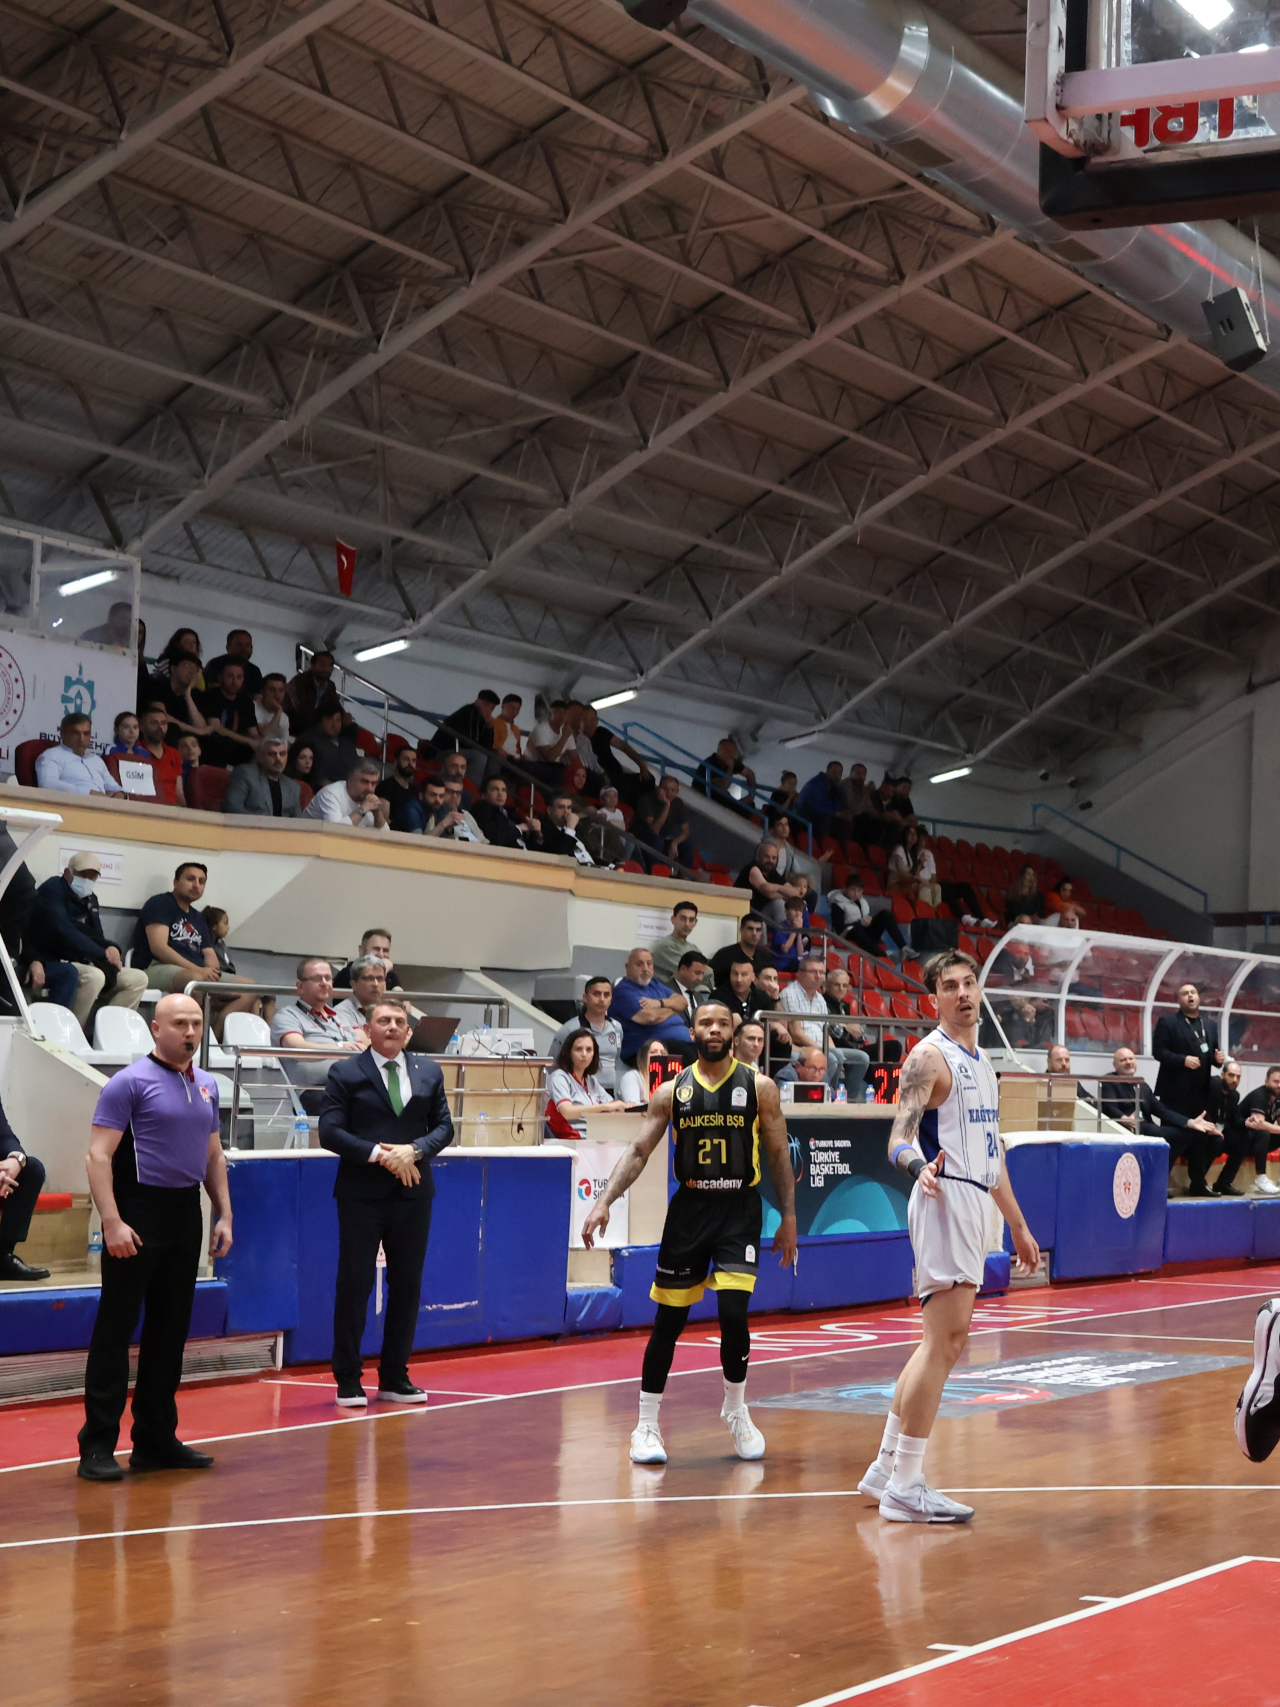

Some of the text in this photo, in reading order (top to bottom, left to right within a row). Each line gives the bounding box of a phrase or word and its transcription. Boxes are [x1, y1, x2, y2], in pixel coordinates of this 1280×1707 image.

[698, 1138, 727, 1165] 27
[810, 1150, 841, 1163] TÜRKİYE
[810, 1163, 852, 1175] BASKETBOL
